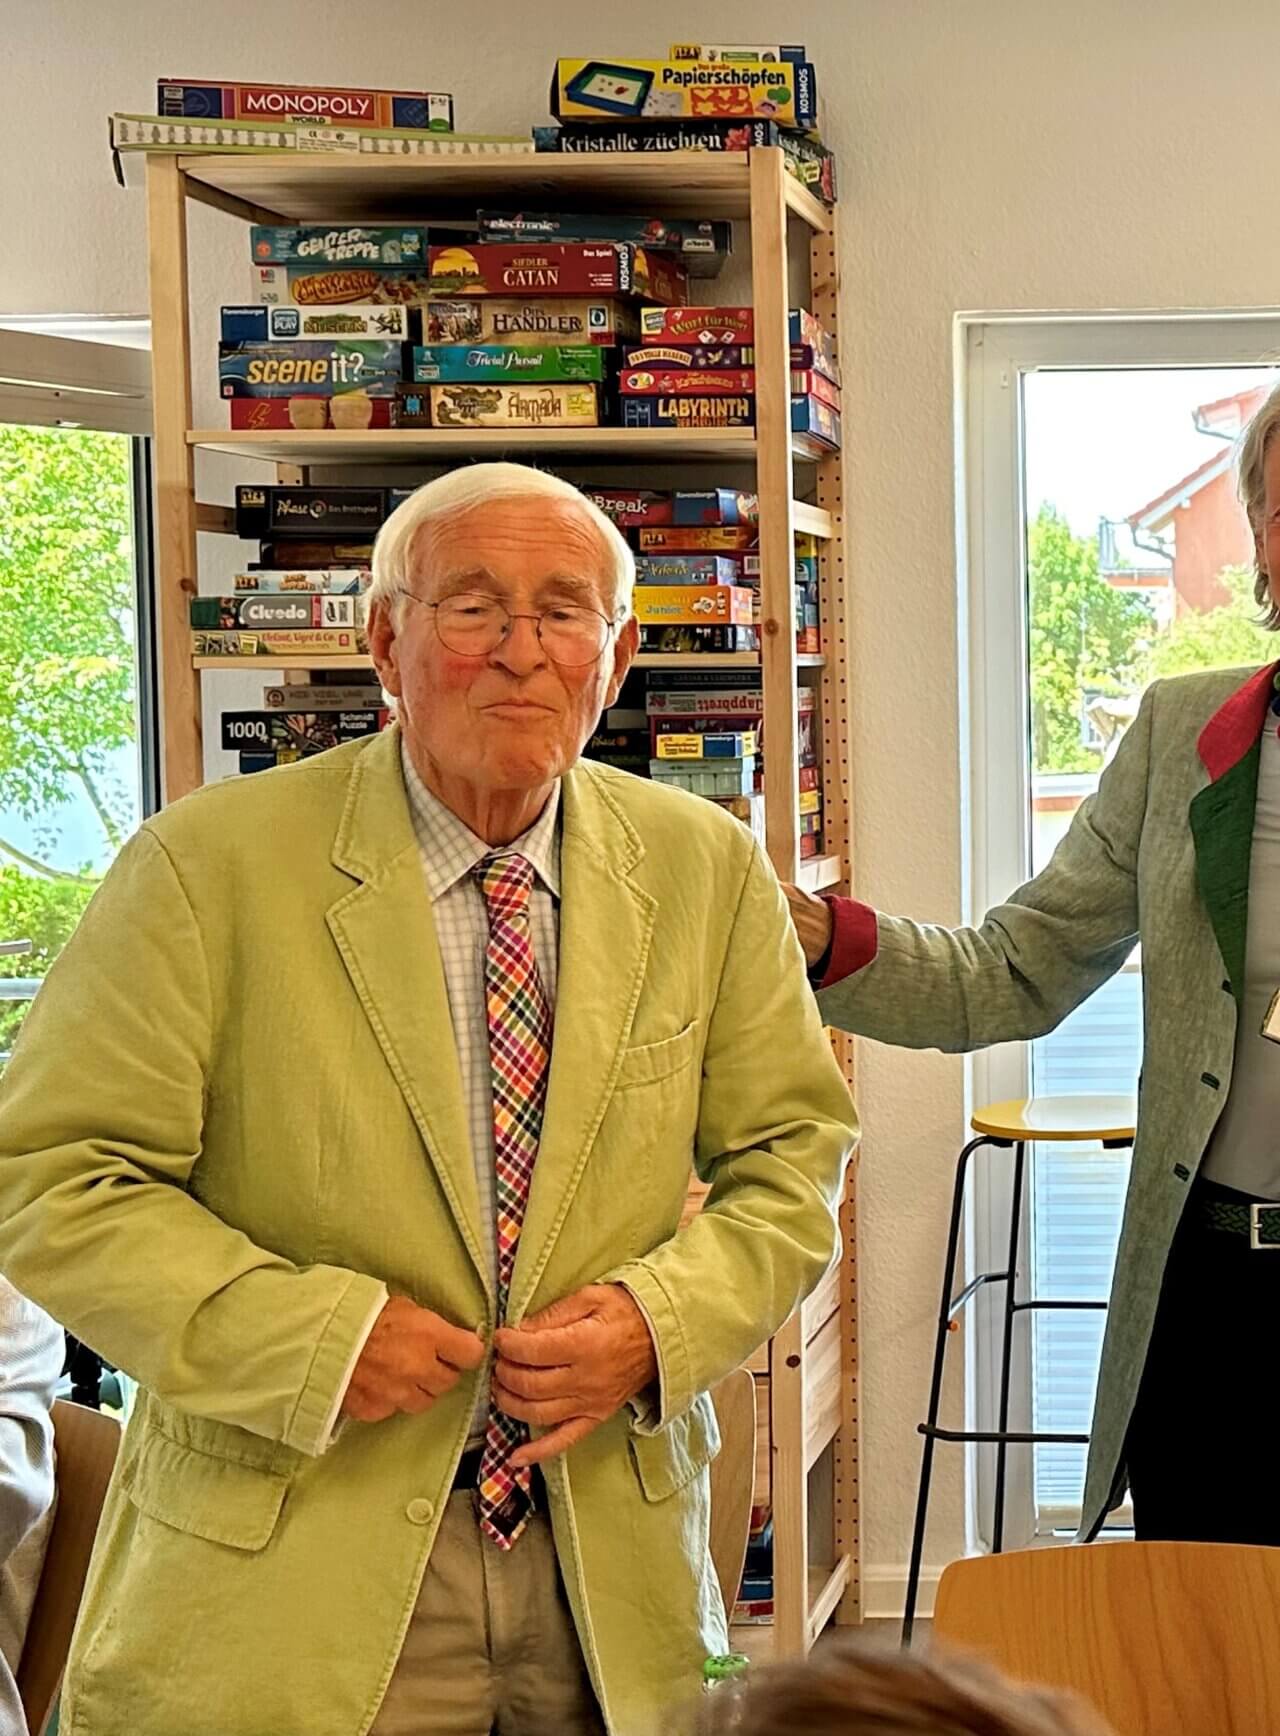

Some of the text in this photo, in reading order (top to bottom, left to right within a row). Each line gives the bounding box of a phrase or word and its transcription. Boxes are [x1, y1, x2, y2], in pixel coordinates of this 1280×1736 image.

[662, 67, 786, 88] Papierschöpfen
[799, 68, 809, 114] KOSMOS
[246, 93, 371, 117] MONOPOLY
[291, 116, 327, 126] WORLD
[560, 132, 723, 151] Kristalle züchten
[488, 218, 554, 231] electronic
[324, 243, 380, 261] TREPPE
[583, 249, 613, 258] Das Spiel
[512, 257, 549, 267] SIEDLER
[618, 245, 630, 290] KOSMOS
[503, 269, 559, 287] CATAN
[669, 317, 703, 336] Wort
[247, 352, 365, 384] scene it?
[466, 350, 505, 368] Trivial
[504, 350, 543, 370] Pursuit
[658, 398, 749, 417] LABYRINTH
[249, 604, 308, 620] Cluedo
[339, 712, 376, 721] Schmidt
[339, 721, 368, 729] Puzzle
[226, 721, 267, 739] 1000
